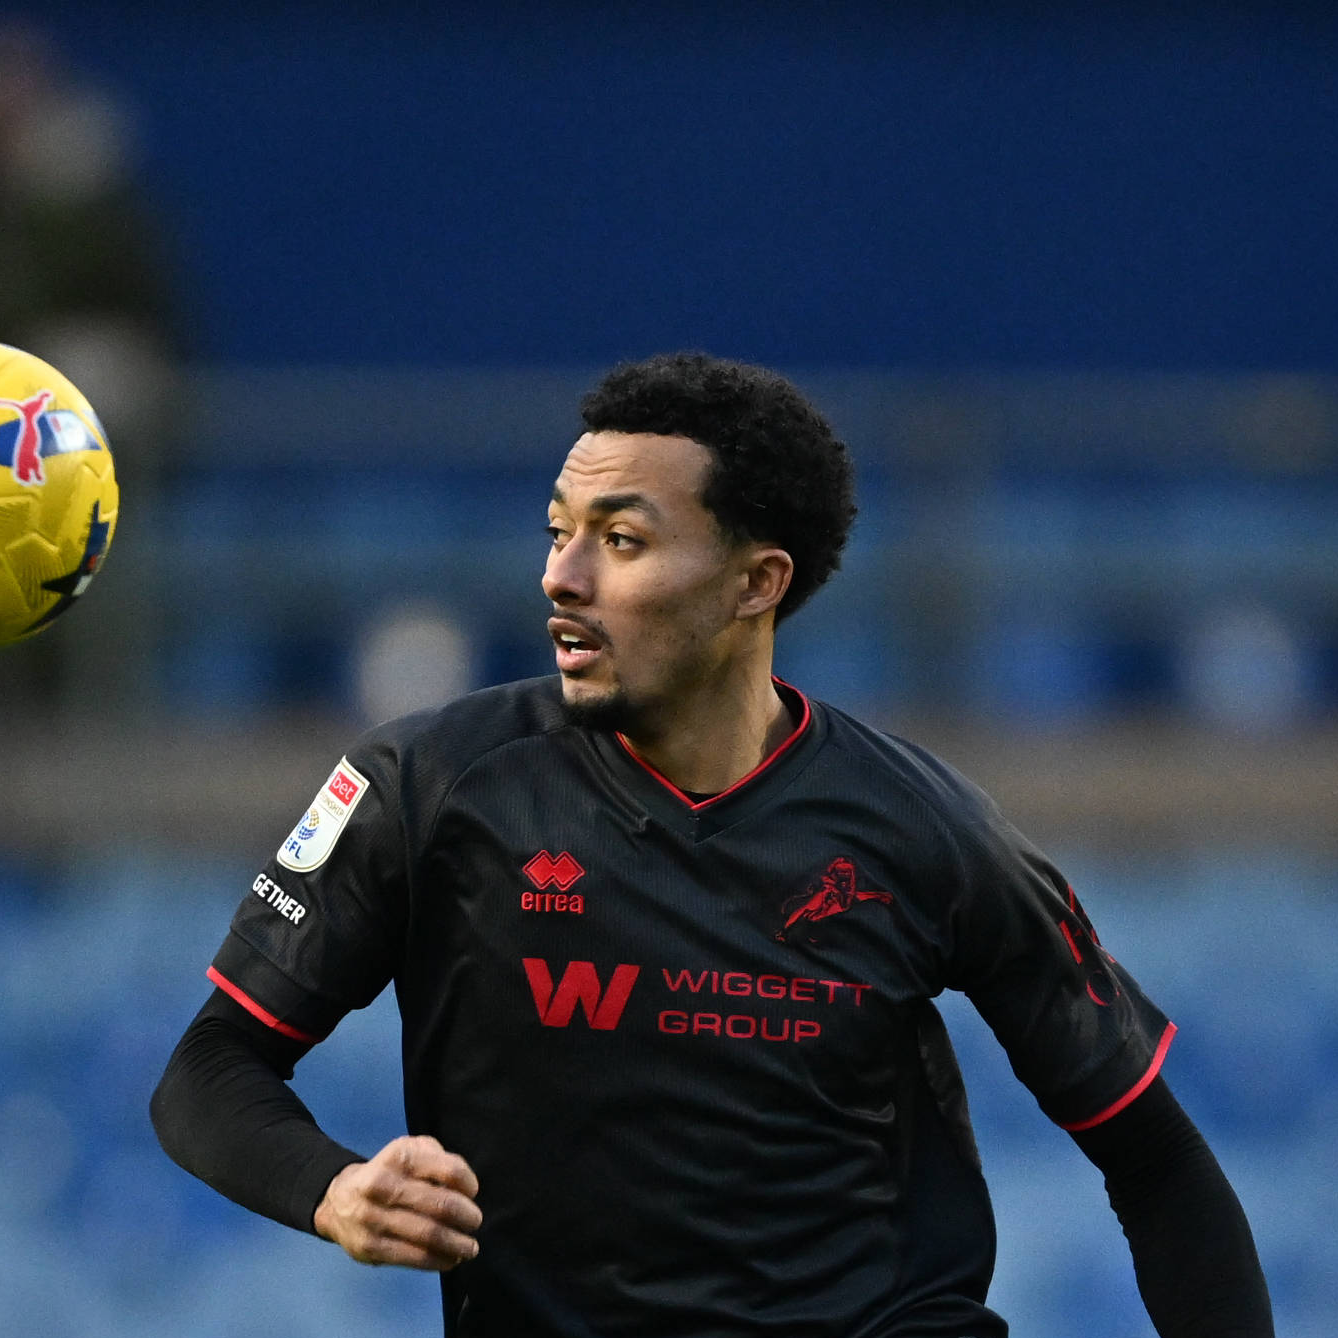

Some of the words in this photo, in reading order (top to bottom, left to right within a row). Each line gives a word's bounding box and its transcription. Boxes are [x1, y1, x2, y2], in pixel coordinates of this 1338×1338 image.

[332, 772, 355, 801] bet
[521, 891, 585, 914] errea
[662, 968, 873, 1007] WIGGETT
[658, 1009, 822, 1043] GROUP
